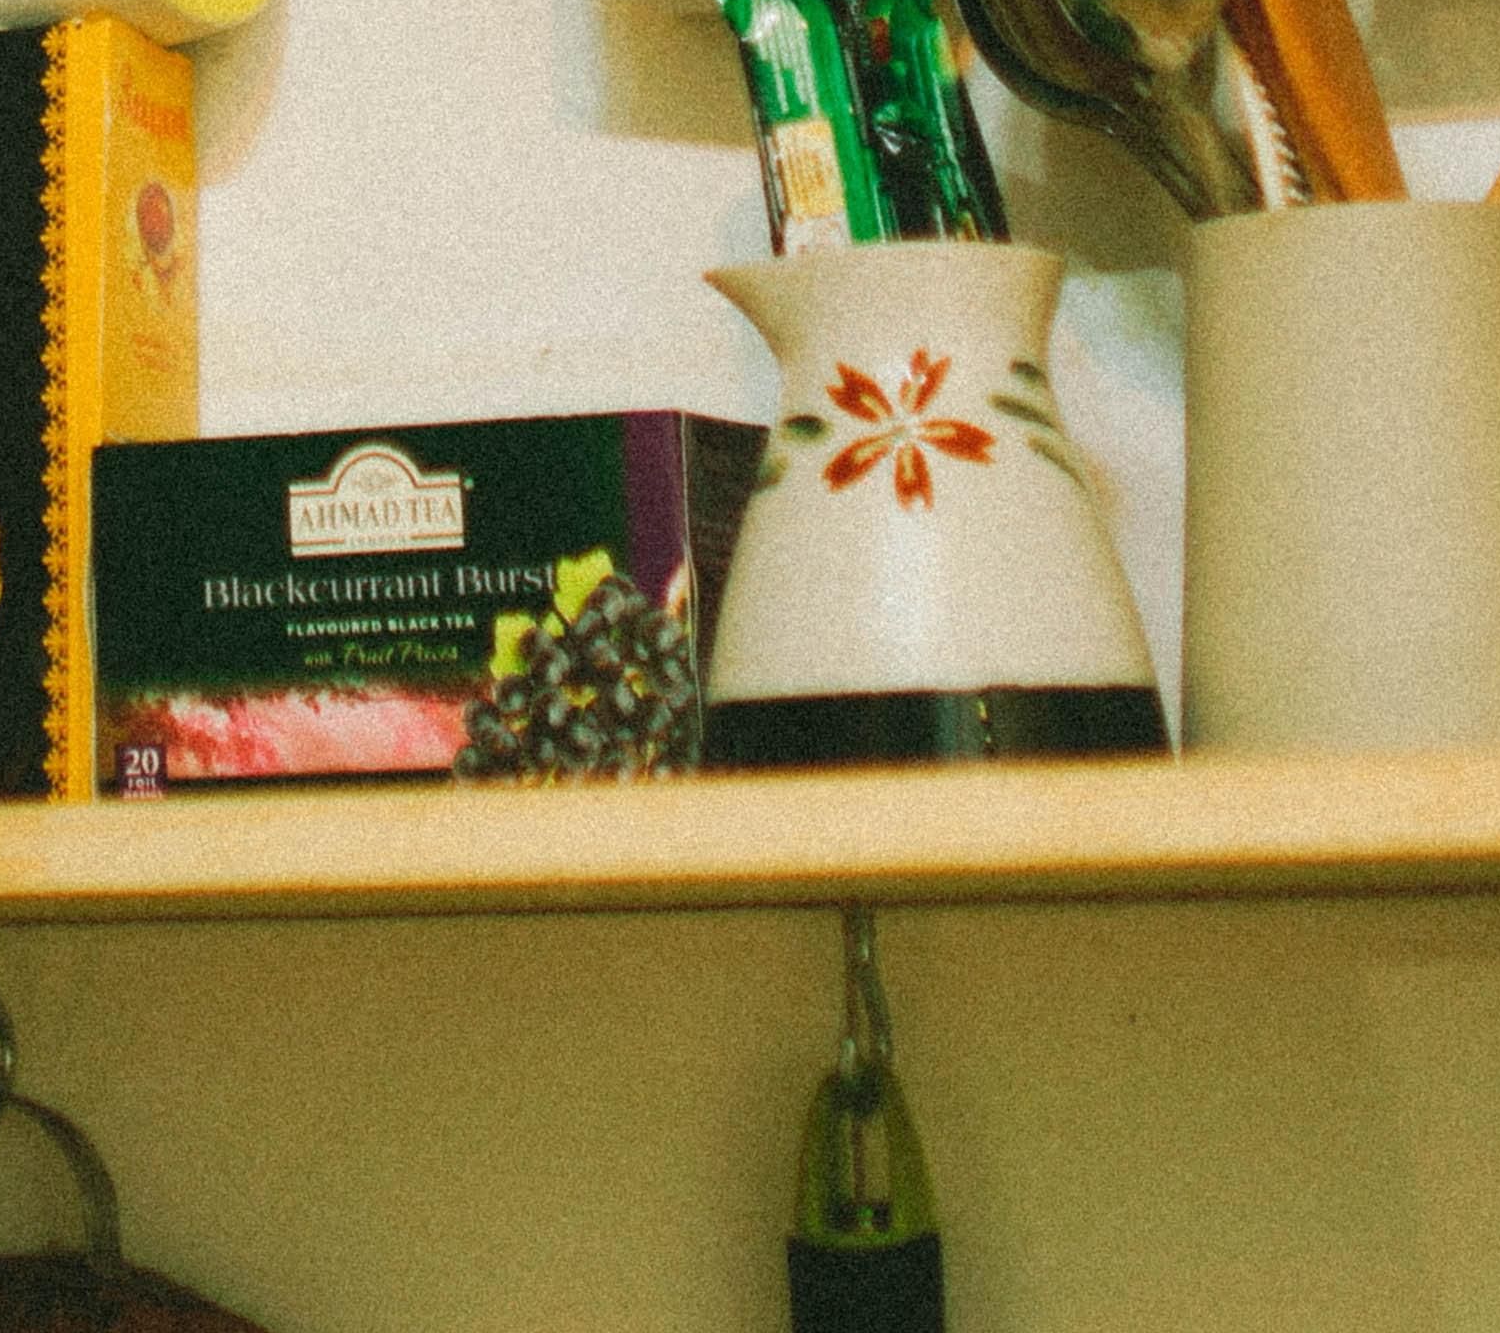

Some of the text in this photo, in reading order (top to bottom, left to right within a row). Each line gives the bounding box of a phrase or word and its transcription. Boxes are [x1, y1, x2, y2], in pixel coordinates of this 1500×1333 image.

[299, 496, 457, 531] AHMAD TEA
[203, 564, 556, 610] Blackcurrant Burst
[286, 615, 475, 637] FLAVOURED BLACK TEA
[304, 653, 333, 666] with
[342, 642, 396, 665] Fruit
[125, 748, 160, 776] 20
